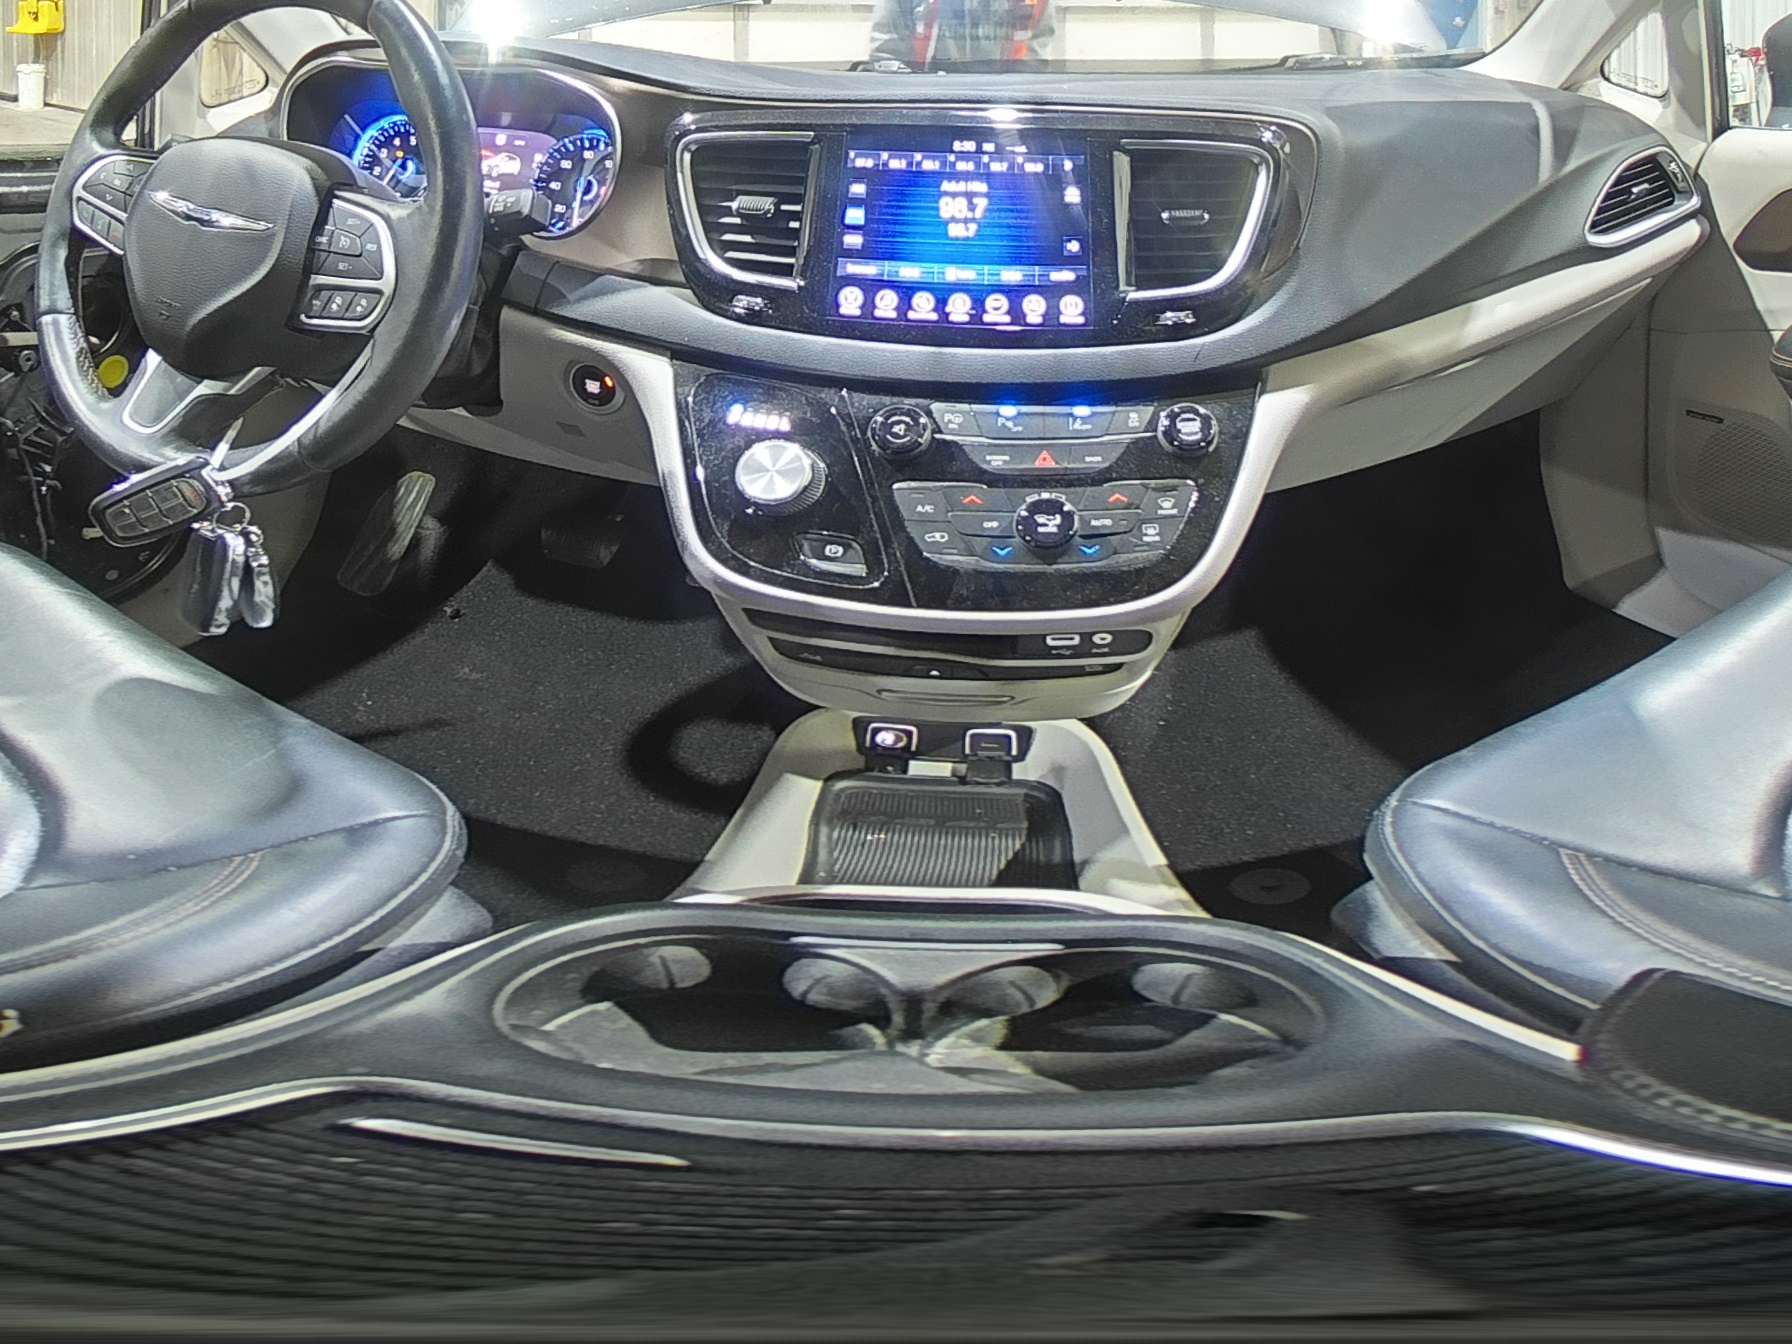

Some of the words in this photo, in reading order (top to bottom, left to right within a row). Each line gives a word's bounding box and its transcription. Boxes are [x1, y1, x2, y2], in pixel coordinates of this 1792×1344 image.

[372, 166, 381, 176] 2
[380, 148, 388, 158] 3
[393, 137, 401, 147] 4
[409, 136, 417, 146] 5
[548, 181, 561, 190] 40
[554, 204, 566, 213] 20
[939, 196, 988, 219] 98.7
[915, 504, 935, 513] A/C
[982, 520, 1000, 529] OFF
[1090, 518, 1113, 527] AUTO
